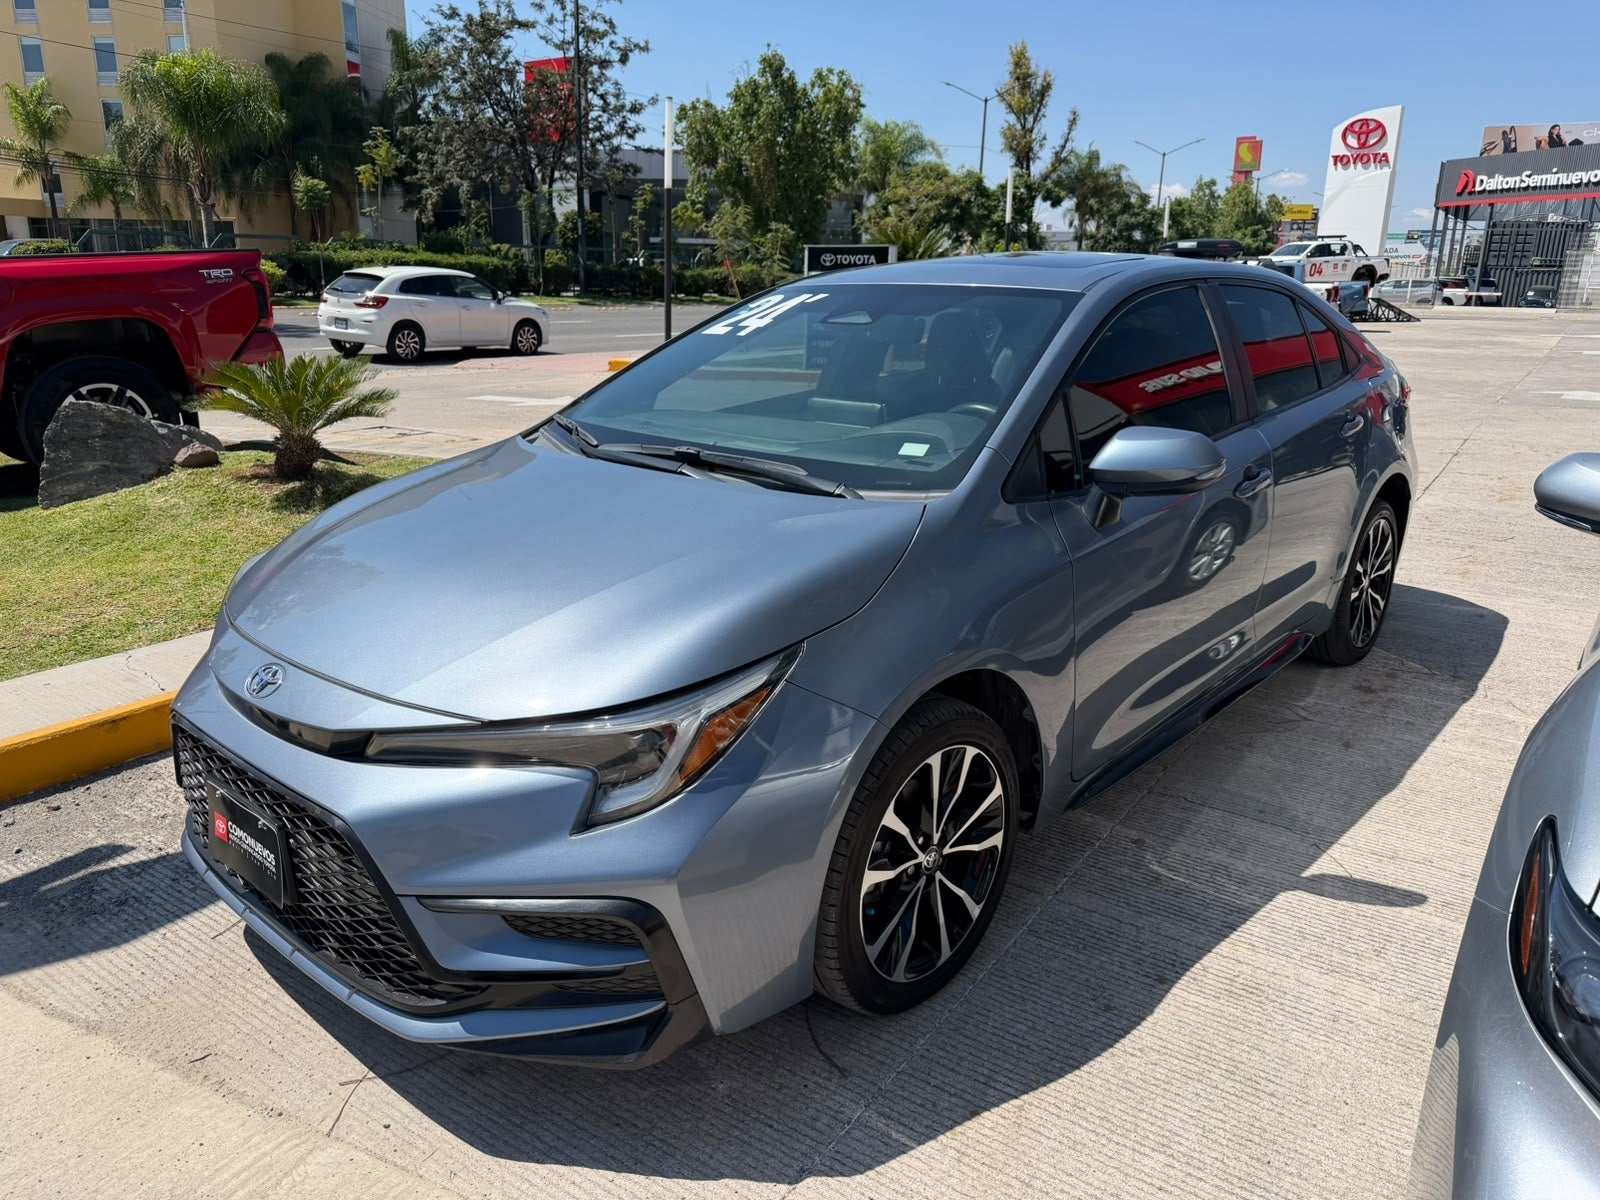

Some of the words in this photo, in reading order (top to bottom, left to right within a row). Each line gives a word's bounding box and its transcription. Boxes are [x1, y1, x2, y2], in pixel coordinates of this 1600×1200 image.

[1331, 152, 1389, 167] TOYOTA
[836, 255, 877, 266] TOYOTA
[198, 268, 233, 278] TRD
[1309, 262, 1323, 277] 04
[228, 821, 276, 866] COMONUEVOS
